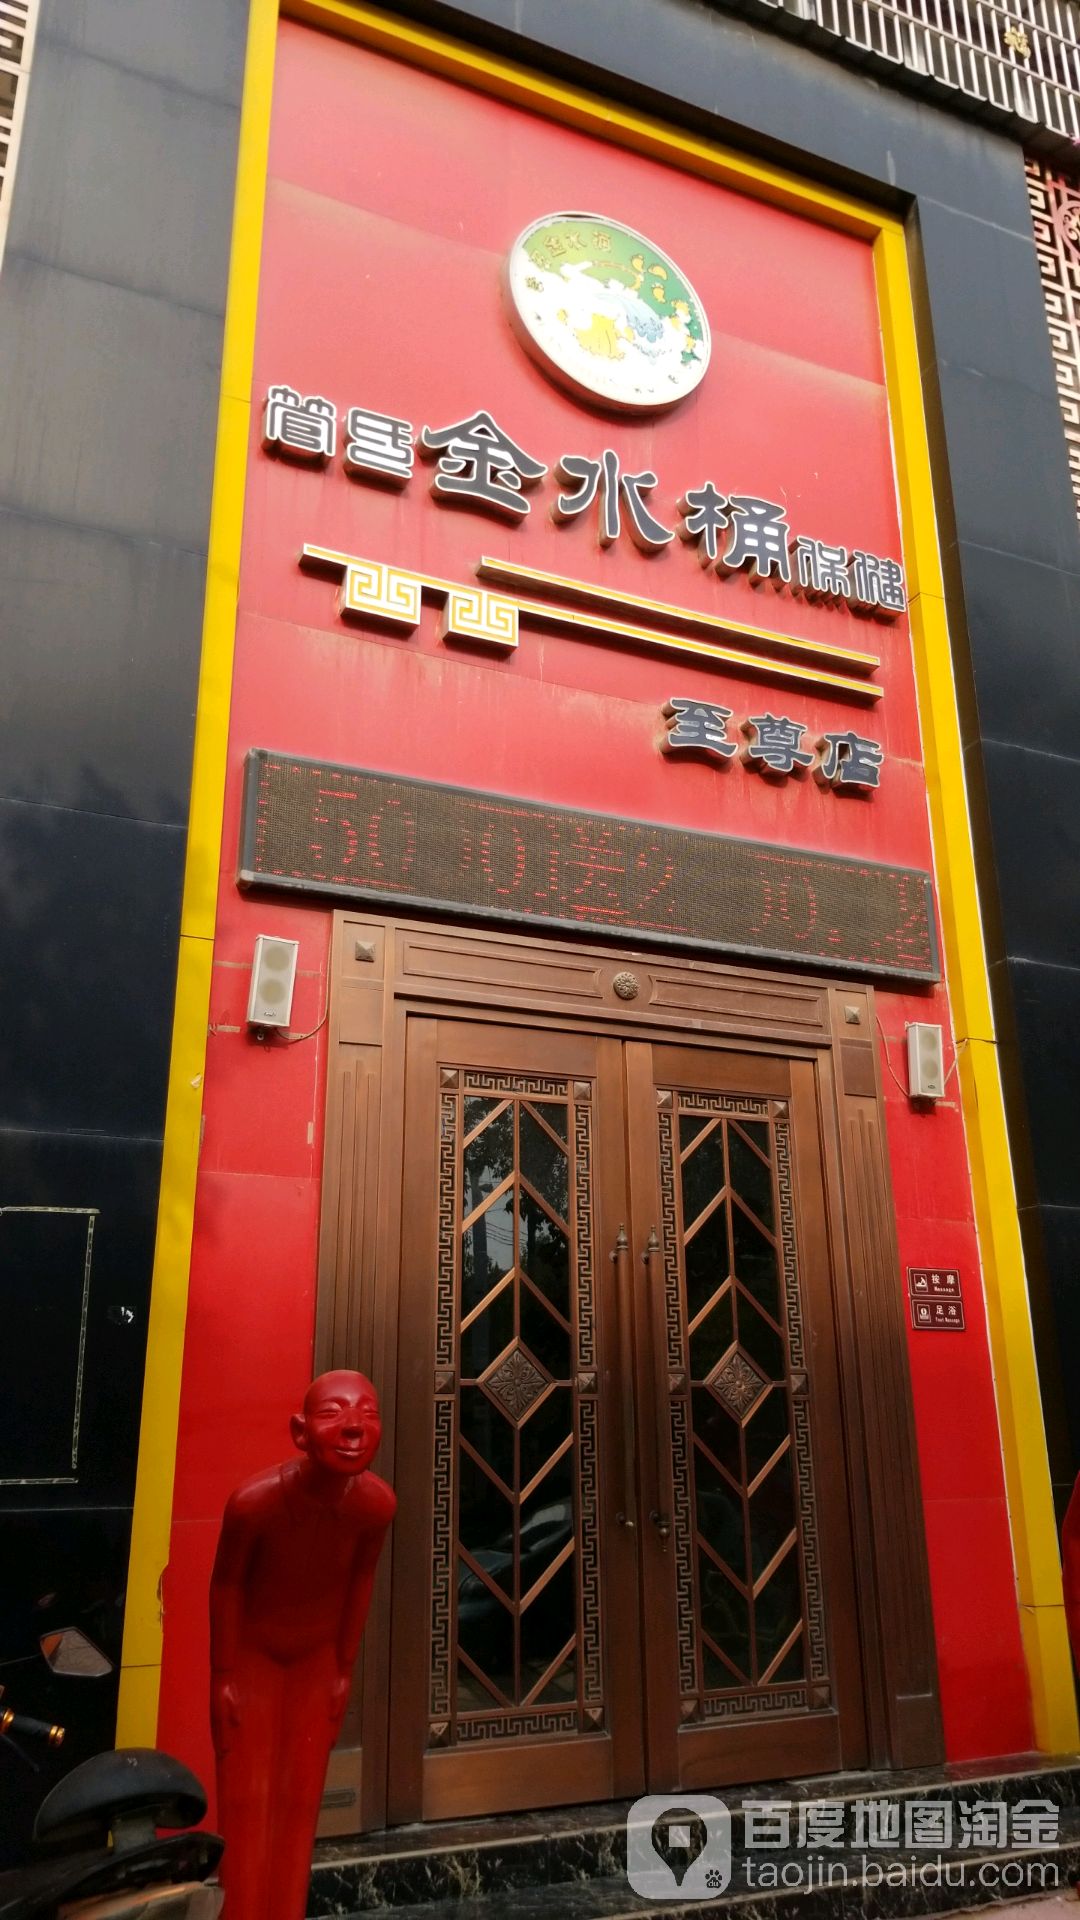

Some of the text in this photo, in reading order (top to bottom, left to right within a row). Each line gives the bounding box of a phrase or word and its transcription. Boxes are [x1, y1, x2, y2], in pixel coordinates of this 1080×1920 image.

[668, 697, 884, 787] 至尊店
[931, 1274, 955, 1285] 按摩
[935, 1304, 957, 1316] 足浴
